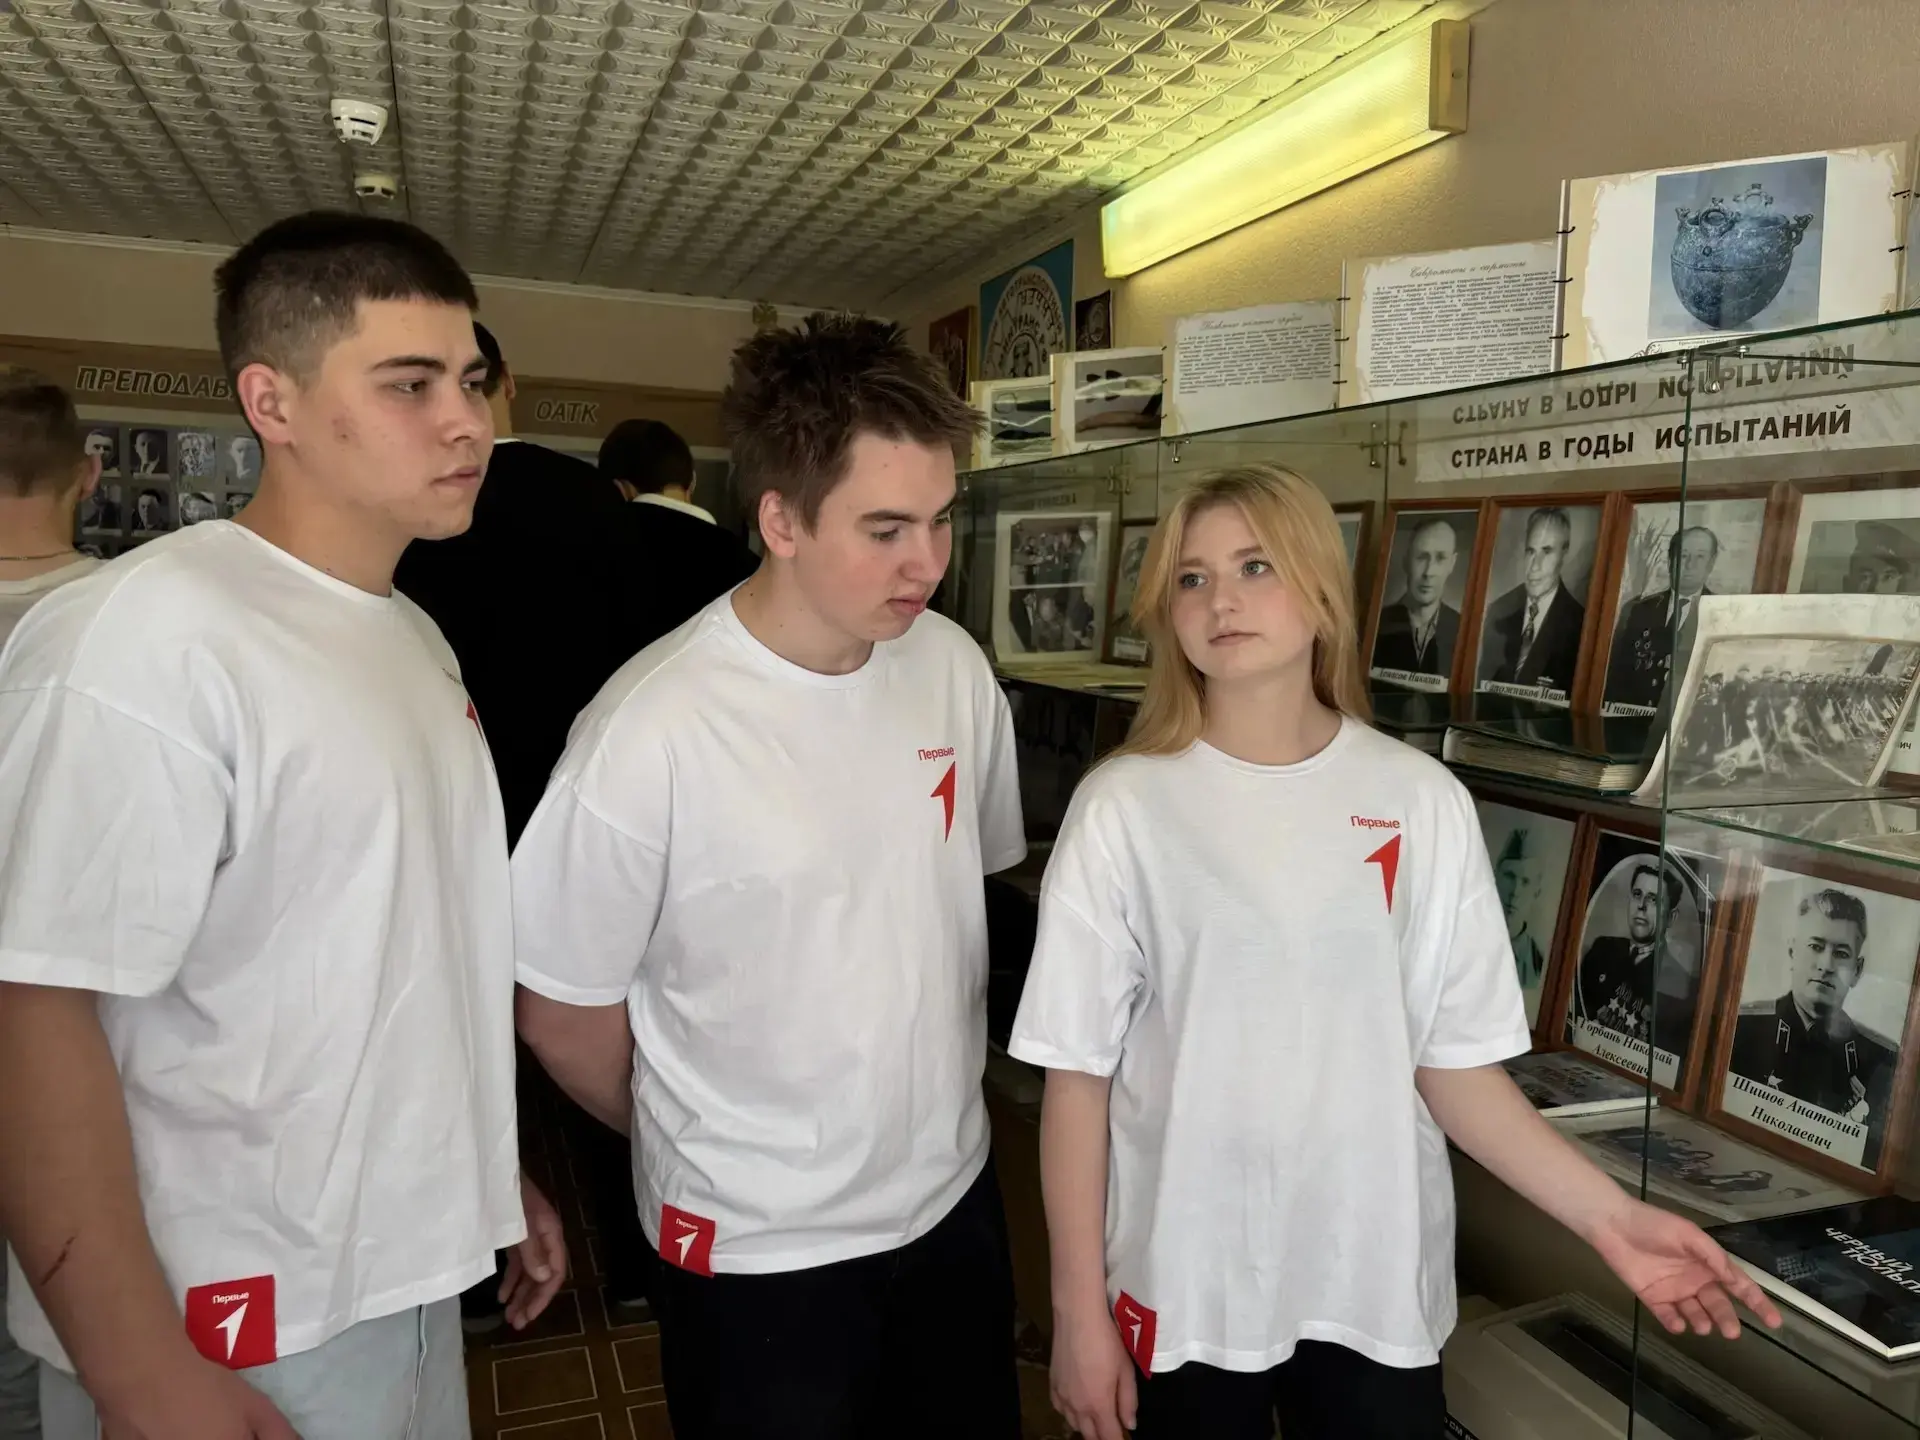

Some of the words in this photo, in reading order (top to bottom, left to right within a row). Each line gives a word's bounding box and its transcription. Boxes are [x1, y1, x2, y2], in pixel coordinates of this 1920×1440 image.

[76, 366, 235, 401] ПРЕПОДАВ
[535, 399, 599, 424] ОАТК
[1451, 442, 1528, 469] СТРАНА
[1538, 440, 1552, 462] В
[1563, 431, 1635, 460] ГОДЫ
[1655, 404, 1852, 450] ИСПЫТАНИЙ
[917, 746, 955, 762] Первые
[1350, 815, 1401, 830] Первые
[1579, 1017, 1622, 1044] Горбань
[1592, 1043, 1650, 1077] Алексеевич
[1732, 1076, 1785, 1108] Шишов
[1788, 1098, 1861, 1139] Анатолий
[1750, 1105, 1833, 1151] Николаевич
[1825, 1227, 1914, 1273] ЧЕРНЫЙ
[1841, 1247, 1920, 1295] ТЮЛЬП
[212, 1291, 250, 1305] Первые
